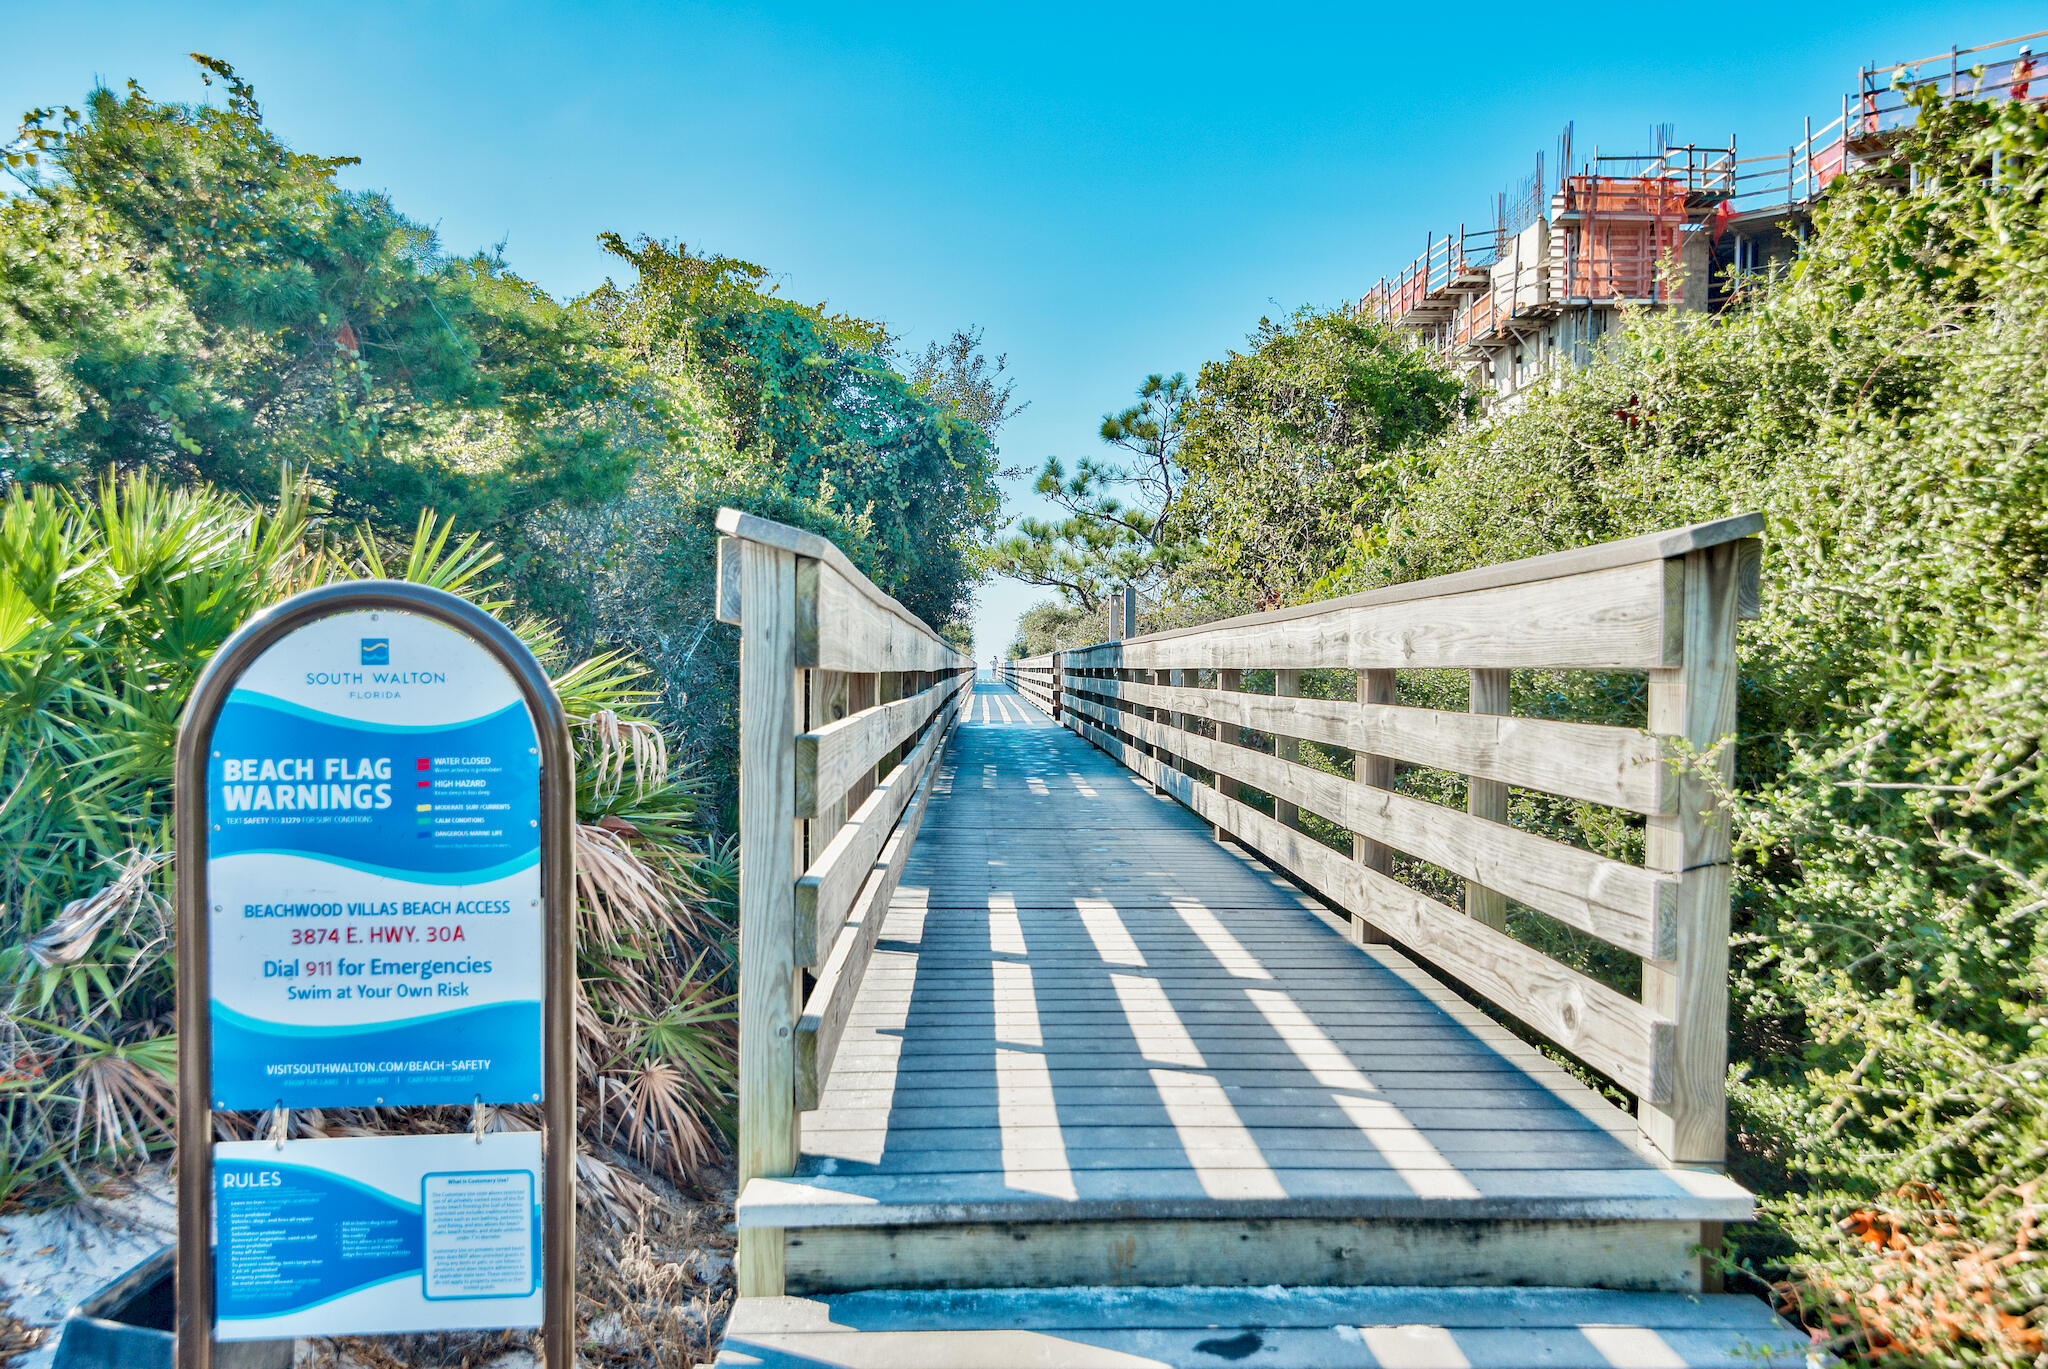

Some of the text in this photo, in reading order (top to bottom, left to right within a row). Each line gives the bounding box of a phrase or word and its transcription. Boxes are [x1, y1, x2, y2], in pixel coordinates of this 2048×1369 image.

[306, 672, 446, 685] SOUTH WALTON
[349, 691, 402, 699] FLORIDA
[223, 757, 392, 782] BEACH FLAG
[434, 756, 492, 765] WATER CLOSED
[434, 779, 487, 788] HIGH HAZARD
[223, 783, 392, 811] WARNINGS
[226, 816, 242, 825] TEXT
[243, 816, 270, 825] SAFETY
[271, 816, 280, 824] TO
[302, 816, 315, 824] FOR
[316, 816, 332, 824] SURF
[334, 815, 373, 824] CONDITIONS
[244, 900, 511, 918] BEACHWOOD VILLAS BEACH ACCESS
[291, 924, 466, 945] 3874 E. HWY. 30A
[263, 955, 493, 980] Dial 911 for Emergencies
[287, 981, 469, 1000] Swim at Your Own Risk
[266, 1060, 491, 1075] VISITSOUTHWALTON.COM/BEACH-SAFETY
[223, 1171, 282, 1189] RULES
